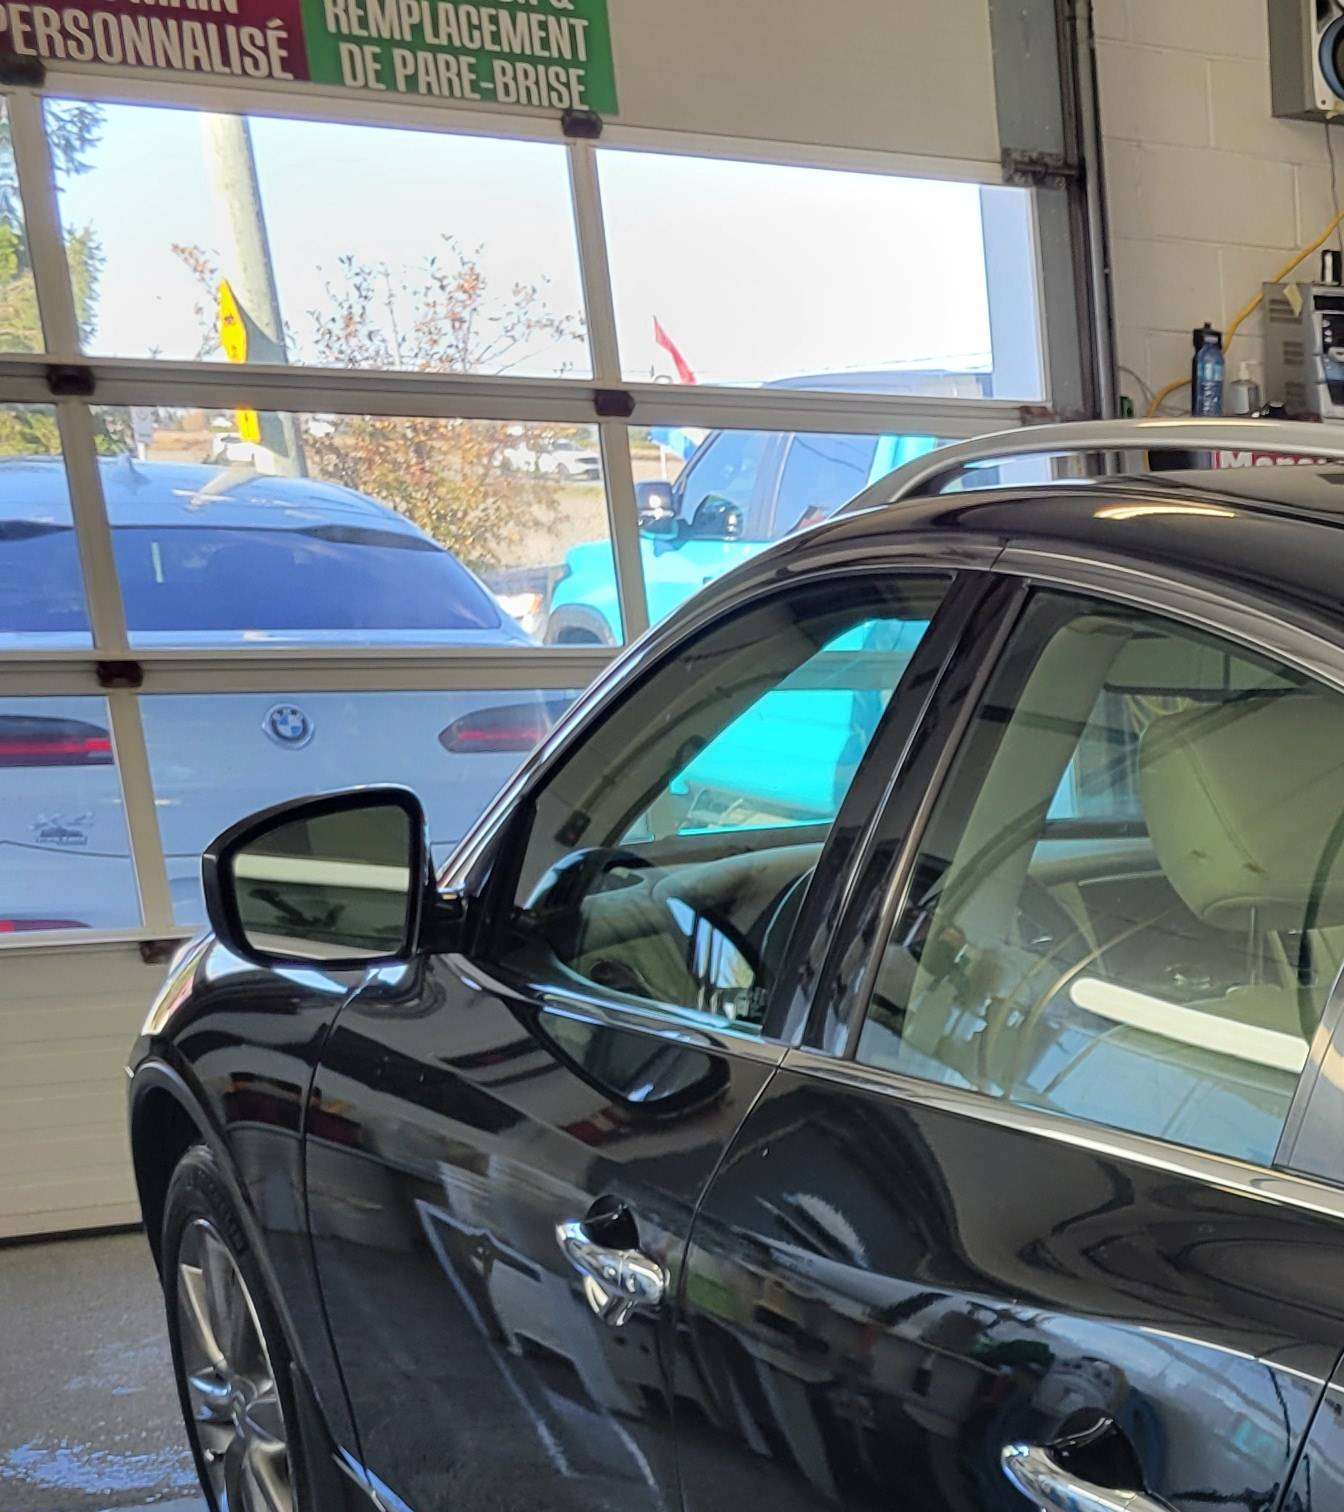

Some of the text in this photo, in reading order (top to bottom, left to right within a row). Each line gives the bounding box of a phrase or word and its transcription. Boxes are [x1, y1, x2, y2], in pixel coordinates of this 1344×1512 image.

[325, 0, 589, 62] REMPLACEMENT
[339, 42, 590, 111] DE PARE-BRISE
